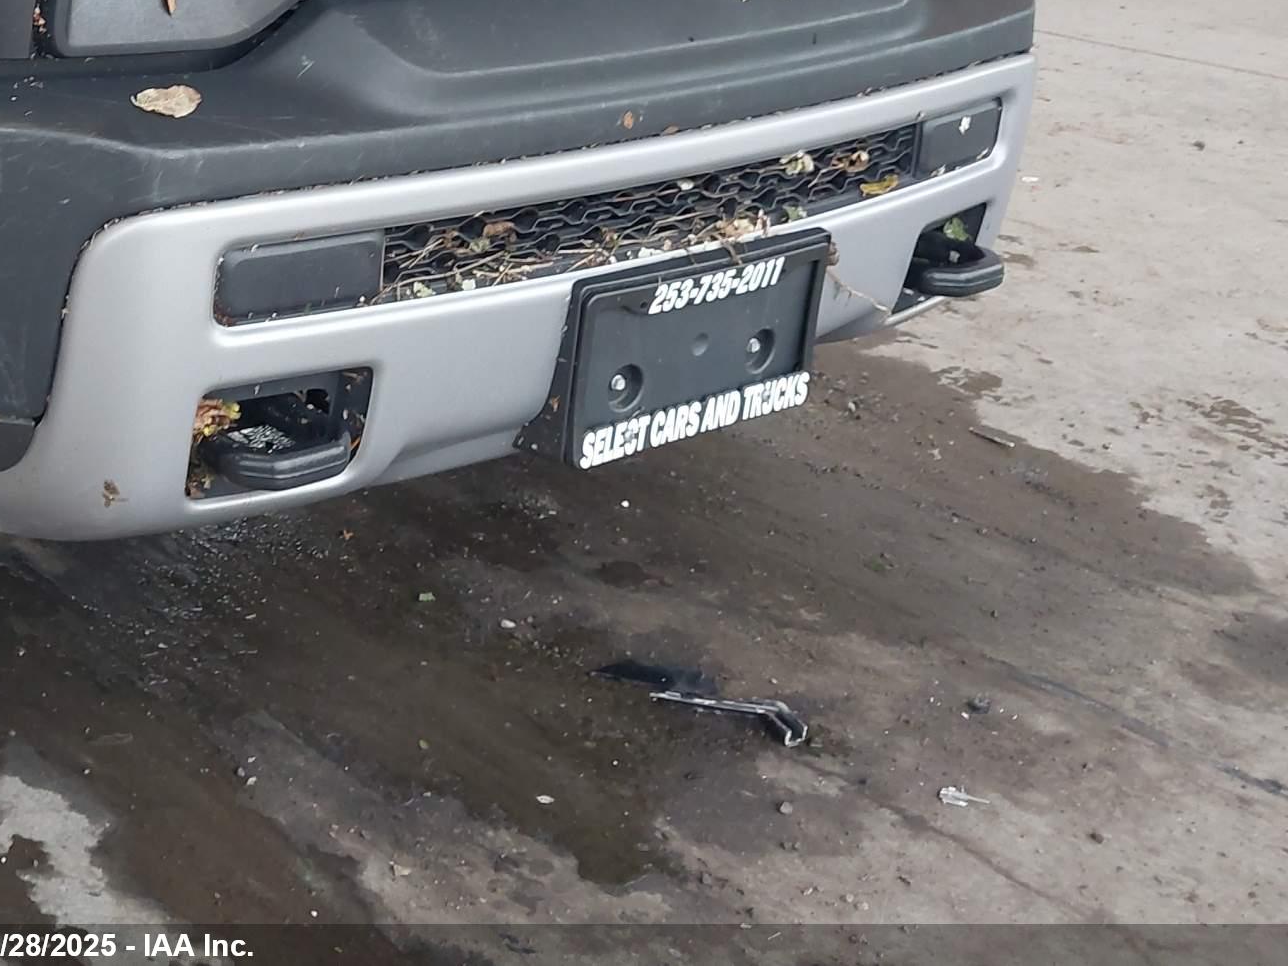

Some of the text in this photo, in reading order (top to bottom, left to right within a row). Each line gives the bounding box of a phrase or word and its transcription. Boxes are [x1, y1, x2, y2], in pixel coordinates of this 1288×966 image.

[648, 256, 786, 315] 253-735-2011
[579, 371, 811, 470] SELECT CARS AND TRUCKS
